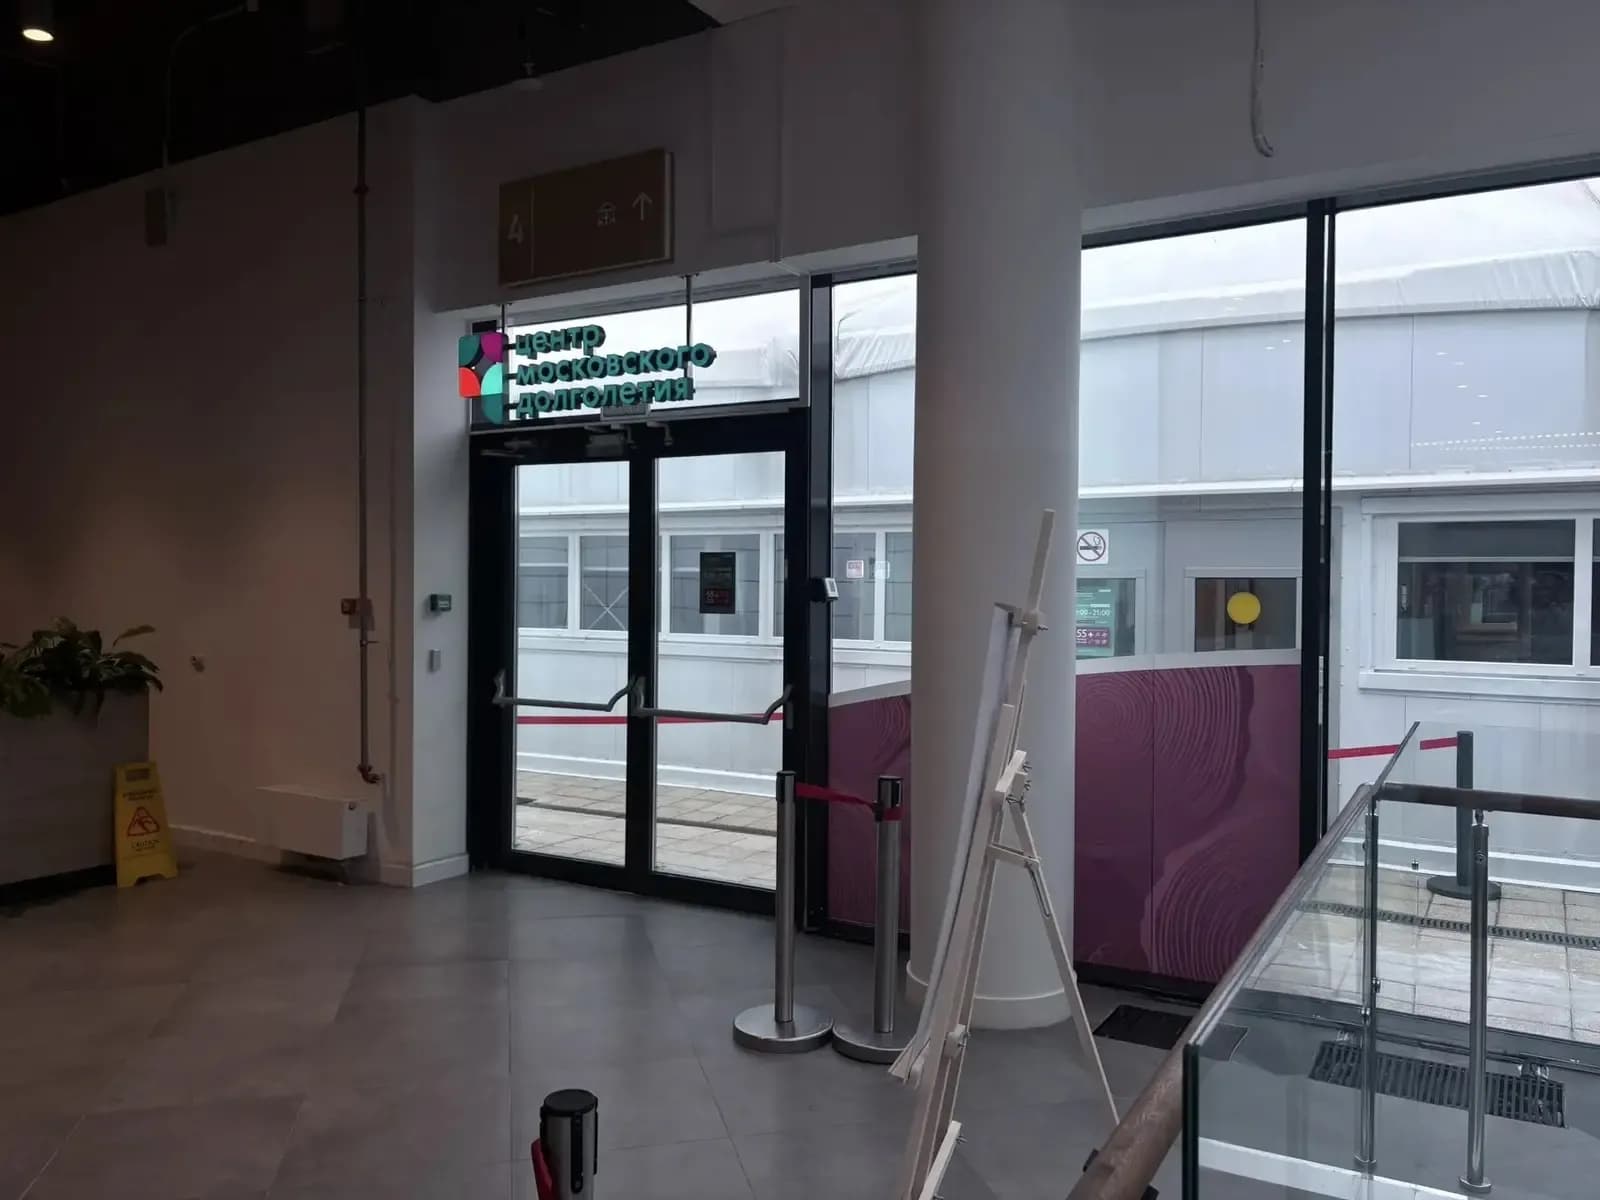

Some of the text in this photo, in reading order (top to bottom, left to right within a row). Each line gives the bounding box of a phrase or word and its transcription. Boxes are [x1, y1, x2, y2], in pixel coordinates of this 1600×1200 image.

[507, 213, 525, 244] 4
[515, 324, 606, 359] центр
[515, 342, 717, 385] московского
[515, 376, 696, 420] долголетия
